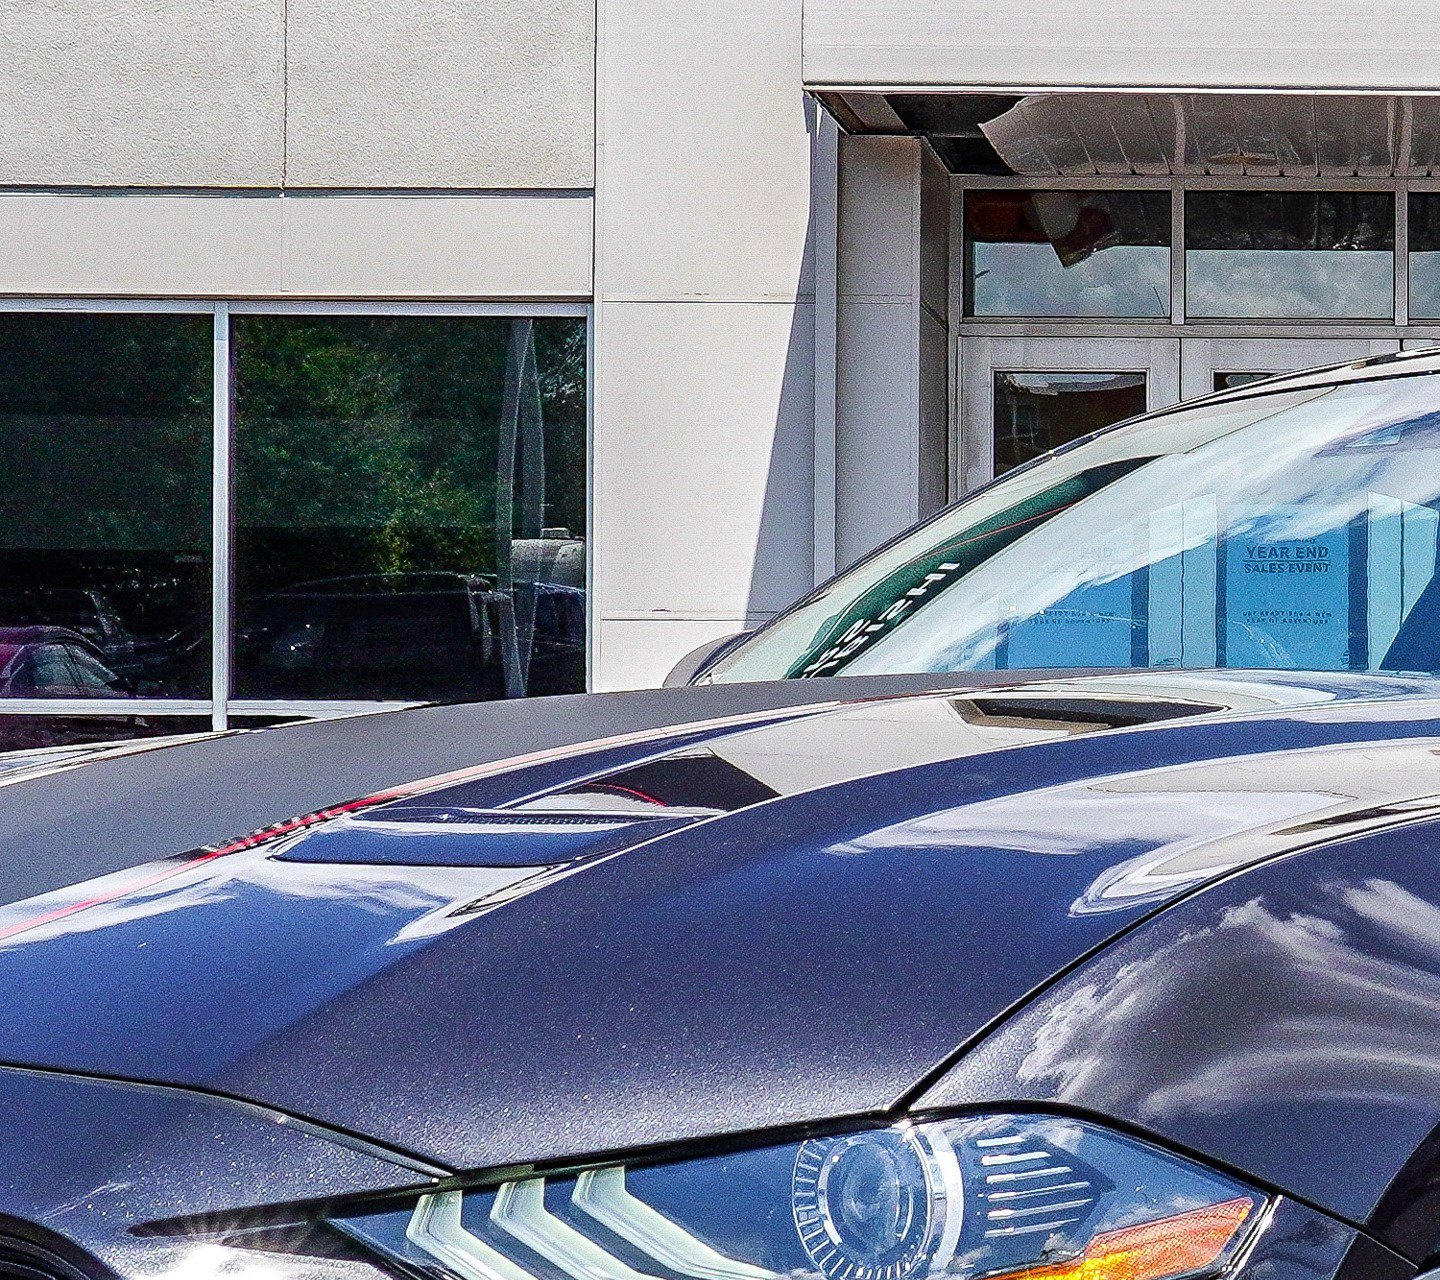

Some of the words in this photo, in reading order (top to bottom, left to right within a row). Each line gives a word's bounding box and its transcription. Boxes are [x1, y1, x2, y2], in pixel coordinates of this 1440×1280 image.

[1246, 546, 1290, 559] YEAR
[1295, 546, 1330, 559] END
[1244, 562, 1285, 574] SALES
[1288, 562, 1331, 574] EVENT
